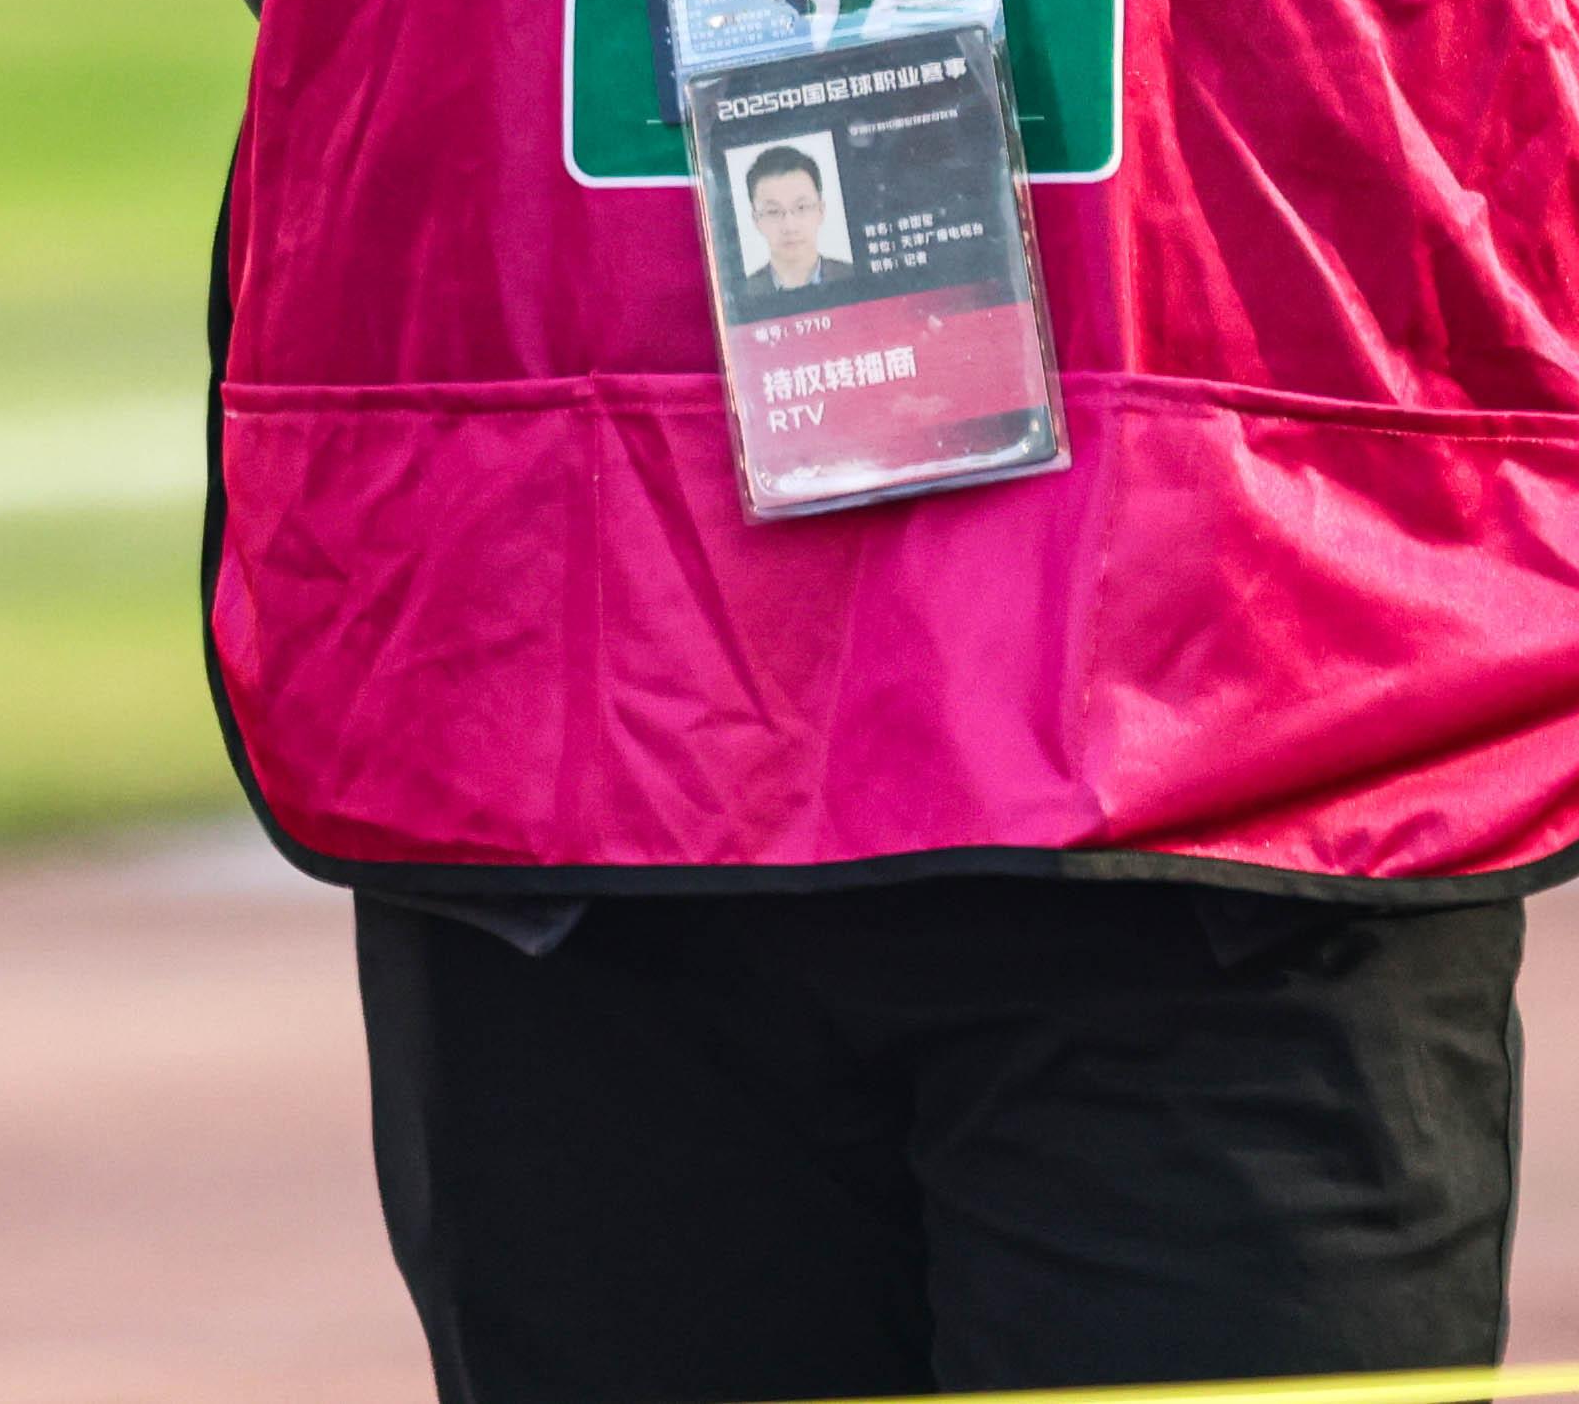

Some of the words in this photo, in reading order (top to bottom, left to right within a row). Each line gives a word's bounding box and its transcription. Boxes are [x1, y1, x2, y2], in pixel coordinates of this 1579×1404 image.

[716, 57, 968, 122] 2025中国足球职业赛事
[763, 345, 917, 403] 持权转播商
[768, 402, 825, 433] RTV
